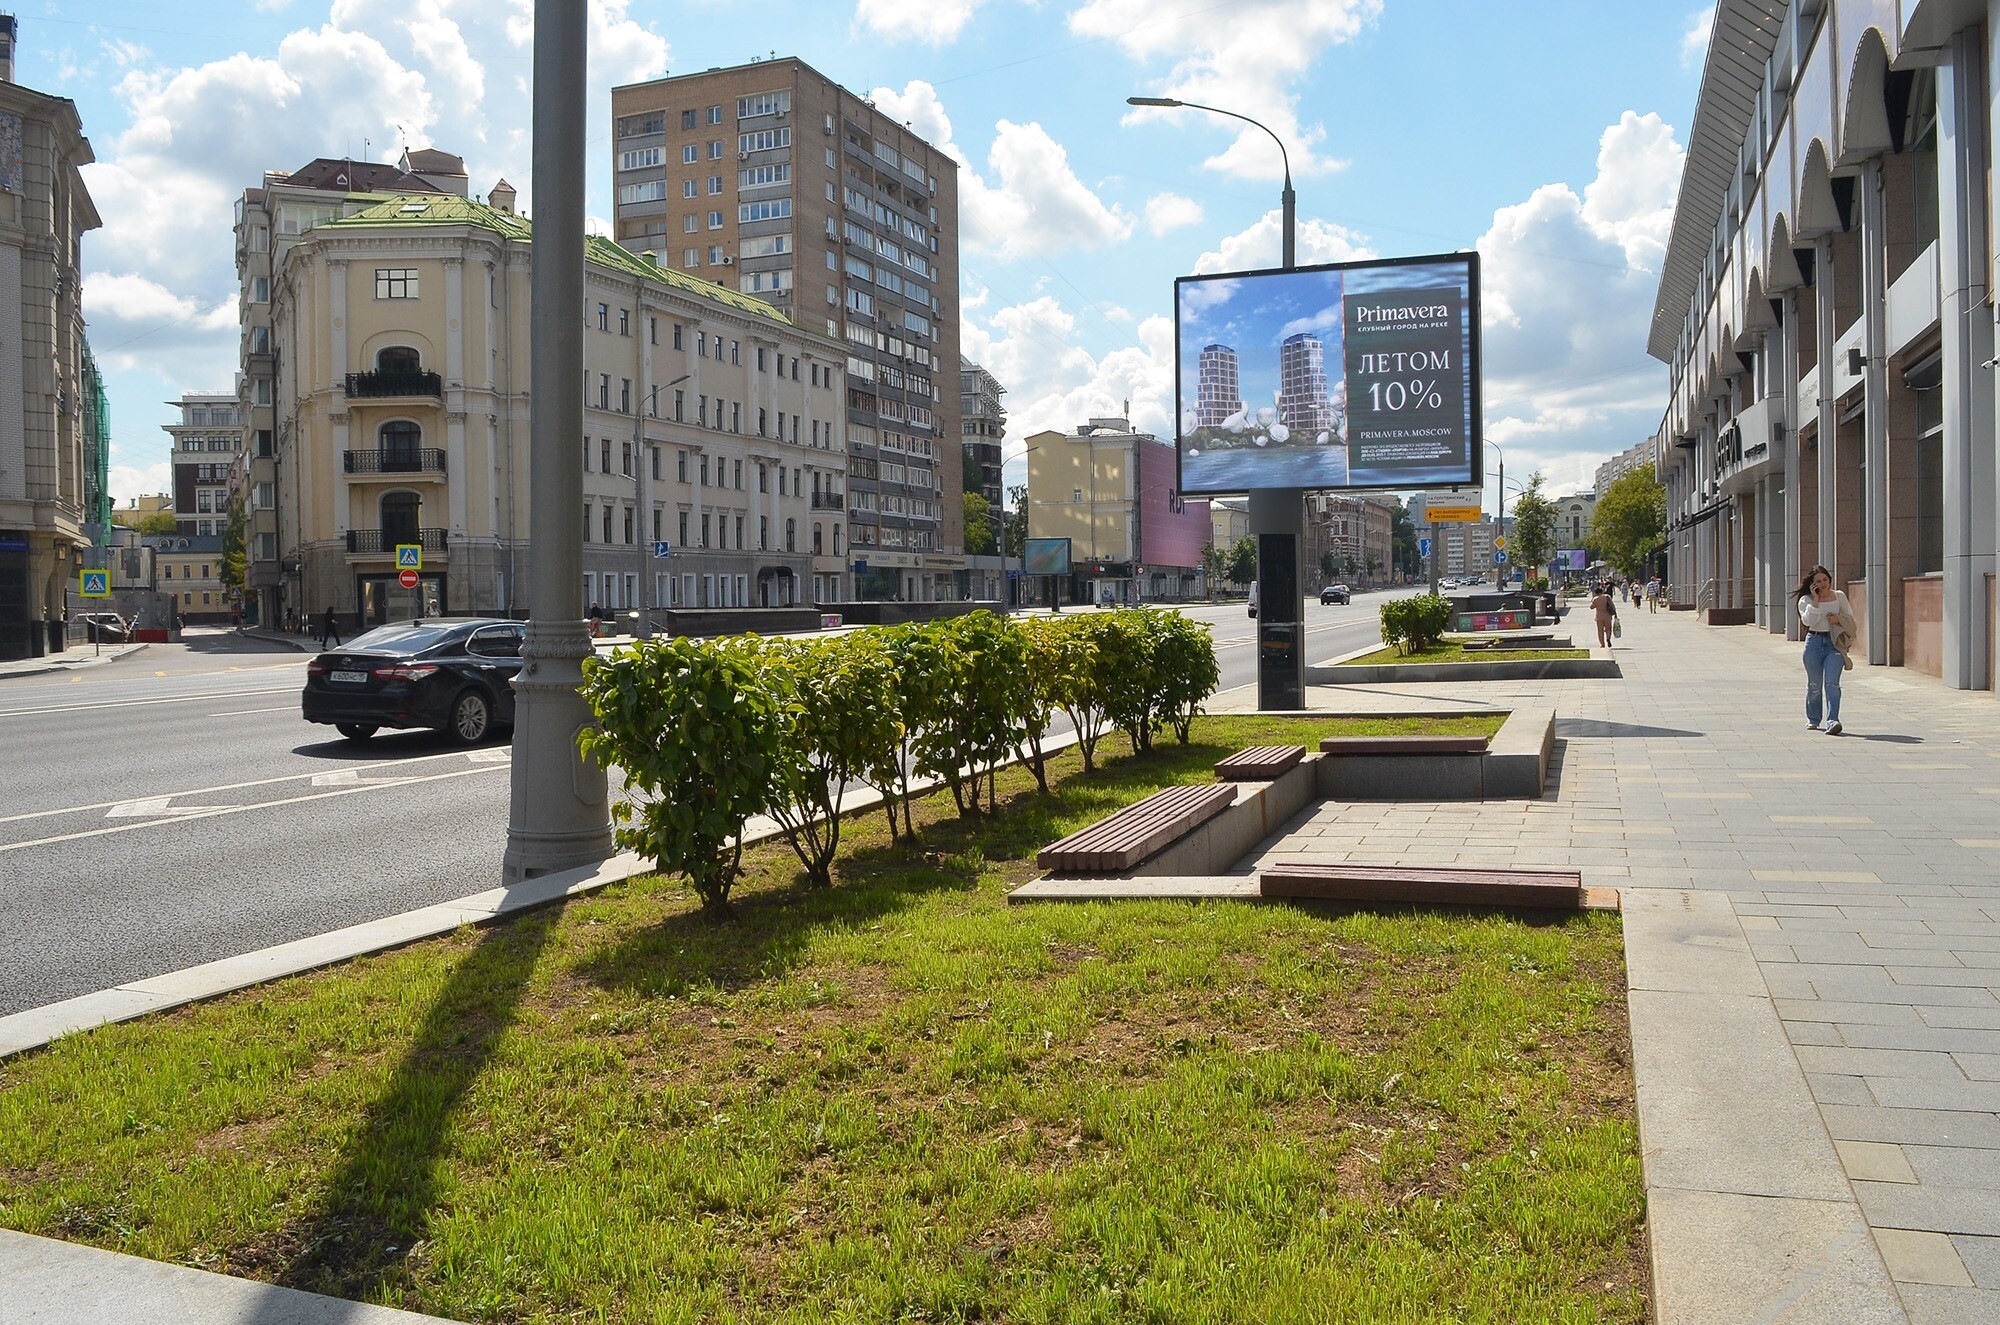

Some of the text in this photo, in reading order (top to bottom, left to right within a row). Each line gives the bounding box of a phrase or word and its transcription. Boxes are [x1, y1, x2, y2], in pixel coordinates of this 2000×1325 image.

[1357, 304, 1448, 322] Primavera
[1357, 324, 1391, 332] КЛУБНЫЙ
[1358, 350, 1450, 374] ЛЕТОМ
[1368, 379, 1442, 411] 10%
[1360, 428, 1452, 439] PRIMAVERA.MOSCOW
